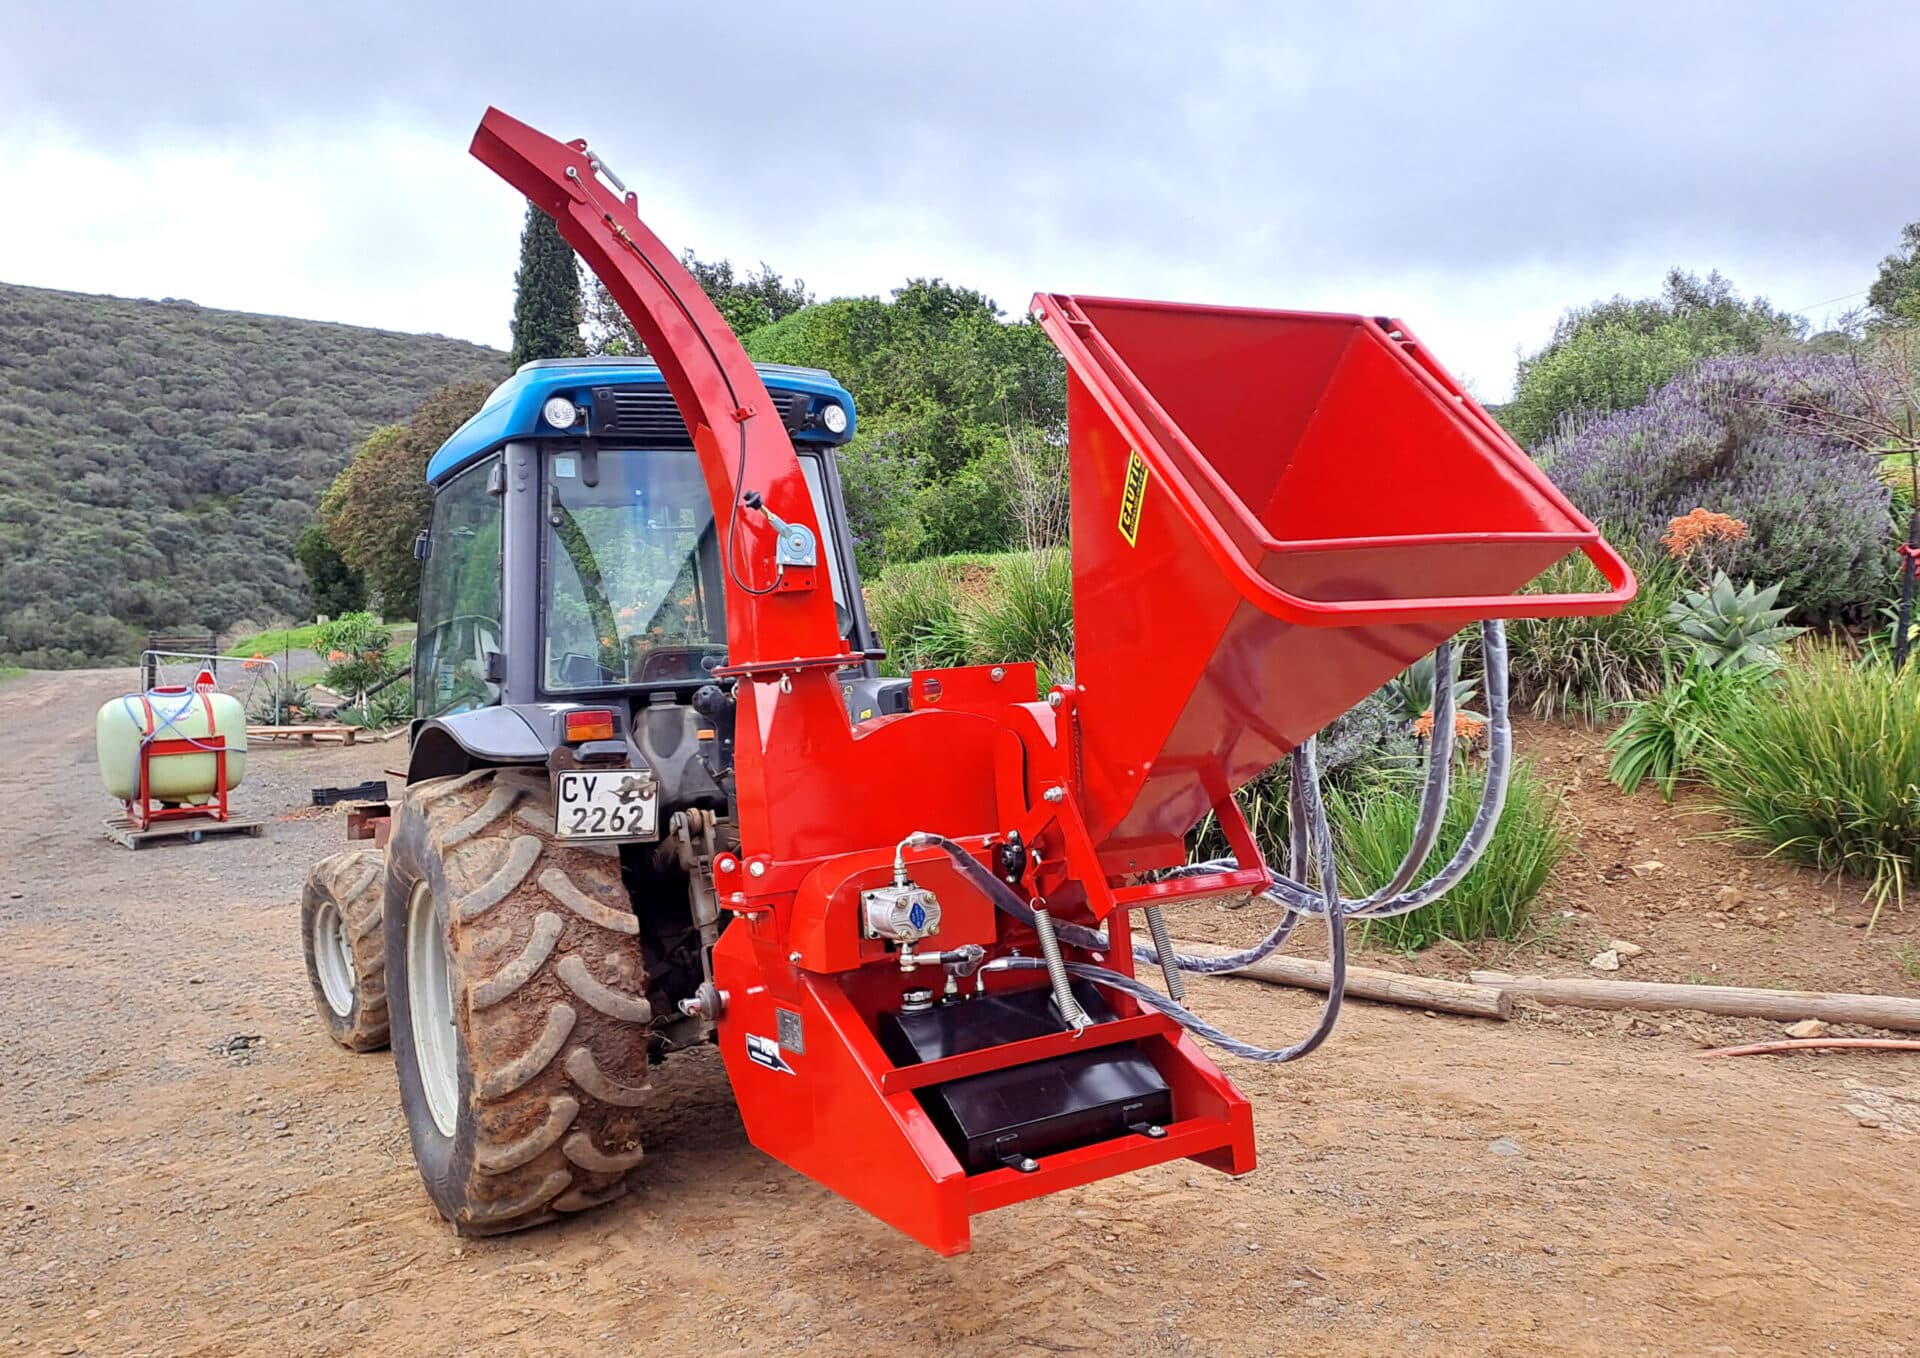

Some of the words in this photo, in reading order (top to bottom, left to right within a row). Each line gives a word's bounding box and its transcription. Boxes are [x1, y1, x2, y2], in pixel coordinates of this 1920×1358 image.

[1123, 453, 1141, 525] CAUTIO
[562, 776, 598, 802] CY
[571, 805, 644, 834] 2262
